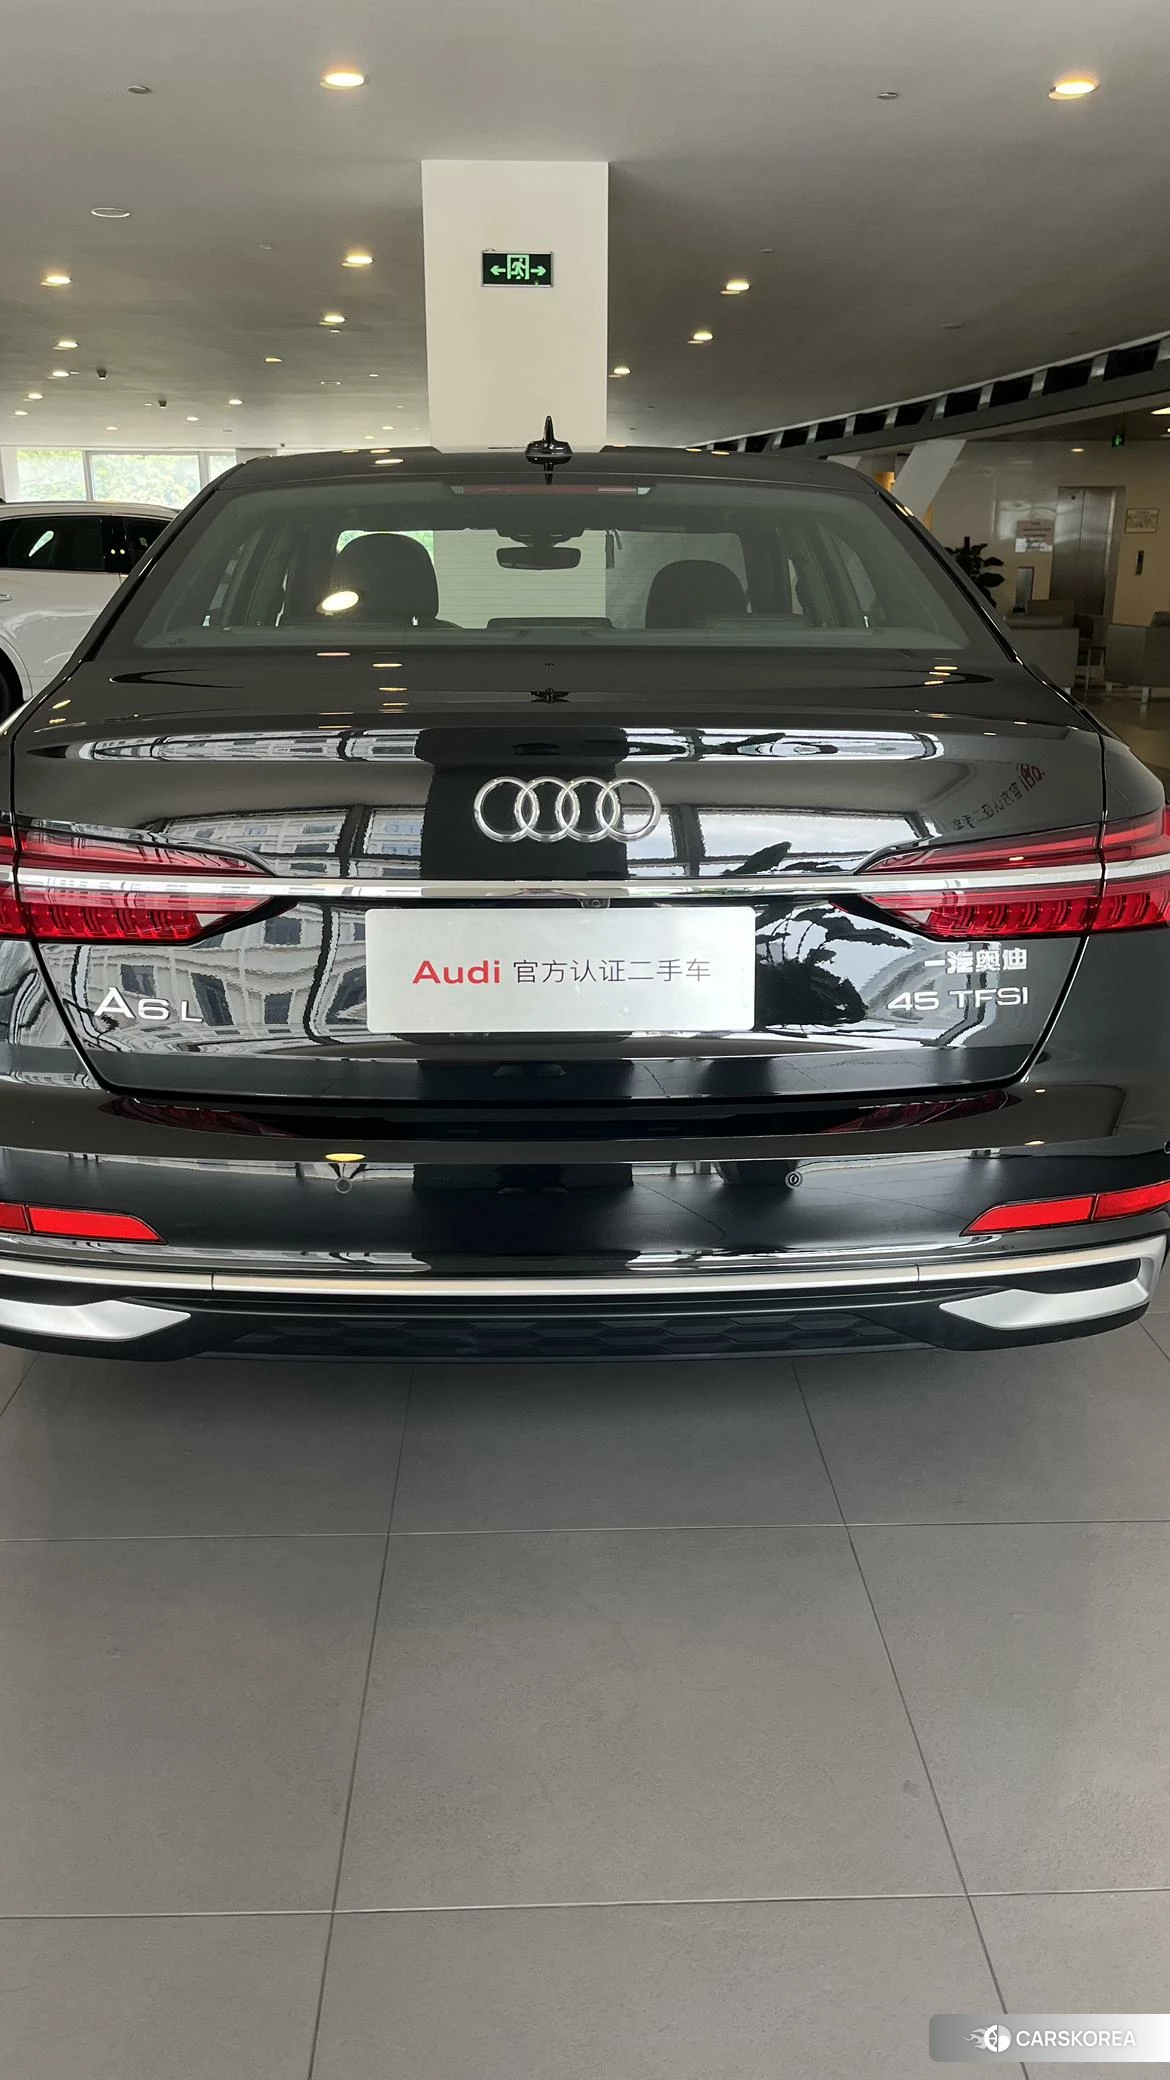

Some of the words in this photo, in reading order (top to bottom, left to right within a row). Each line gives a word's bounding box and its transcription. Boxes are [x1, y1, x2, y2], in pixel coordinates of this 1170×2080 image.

[413, 960, 501, 985] Audi
[513, 958, 711, 984] 官方认证二手车
[924, 948, 1027, 974] 一汽奥迪
[887, 991, 940, 1011] 45
[949, 987, 1028, 1009] TFSI
